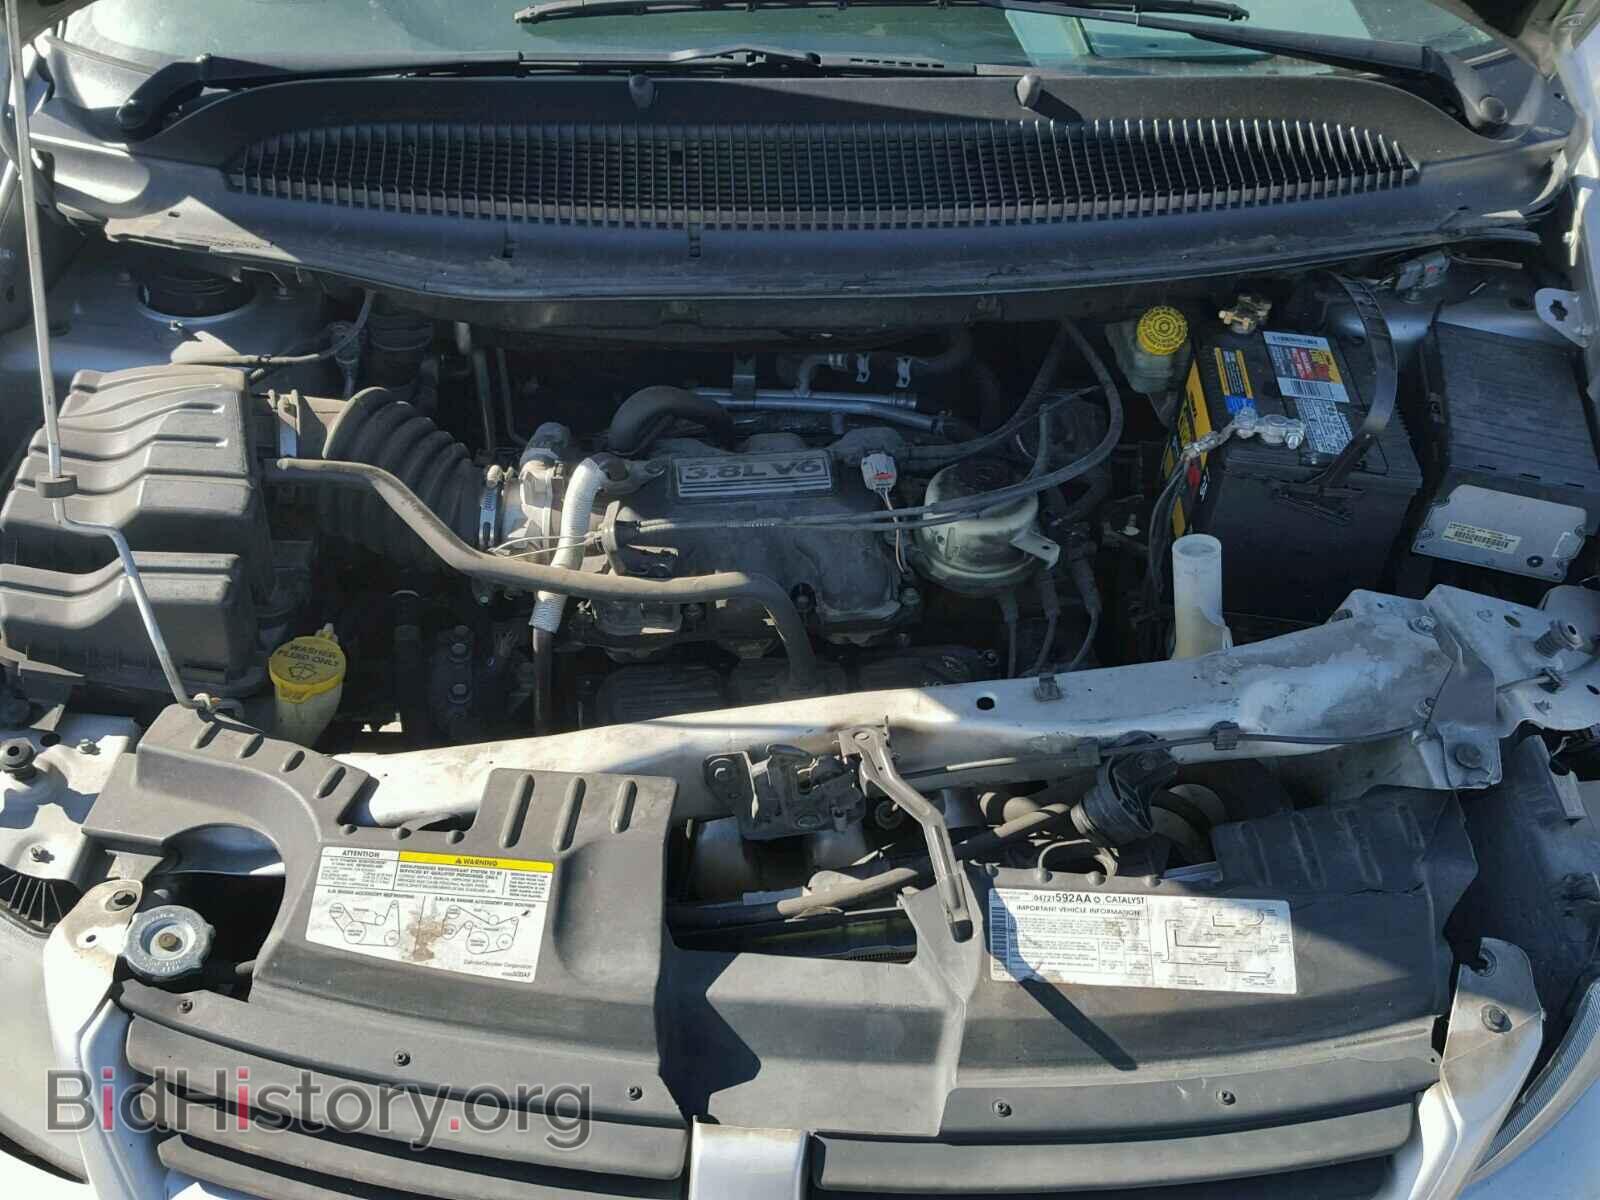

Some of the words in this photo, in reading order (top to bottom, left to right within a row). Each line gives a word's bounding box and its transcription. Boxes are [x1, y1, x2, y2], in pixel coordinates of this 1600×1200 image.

[770, 460, 822, 475] V6
[290, 643, 337, 659] WASHER
[311, 656, 339, 667] ONLY
[342, 849, 381, 858] ATTENTION
[463, 858, 498, 867] WARNING
[1104, 896, 1145, 905] CATALYST
[1016, 905, 1057, 913] IMPORTANT
[1089, 908, 1141, 917] INFORMATION
